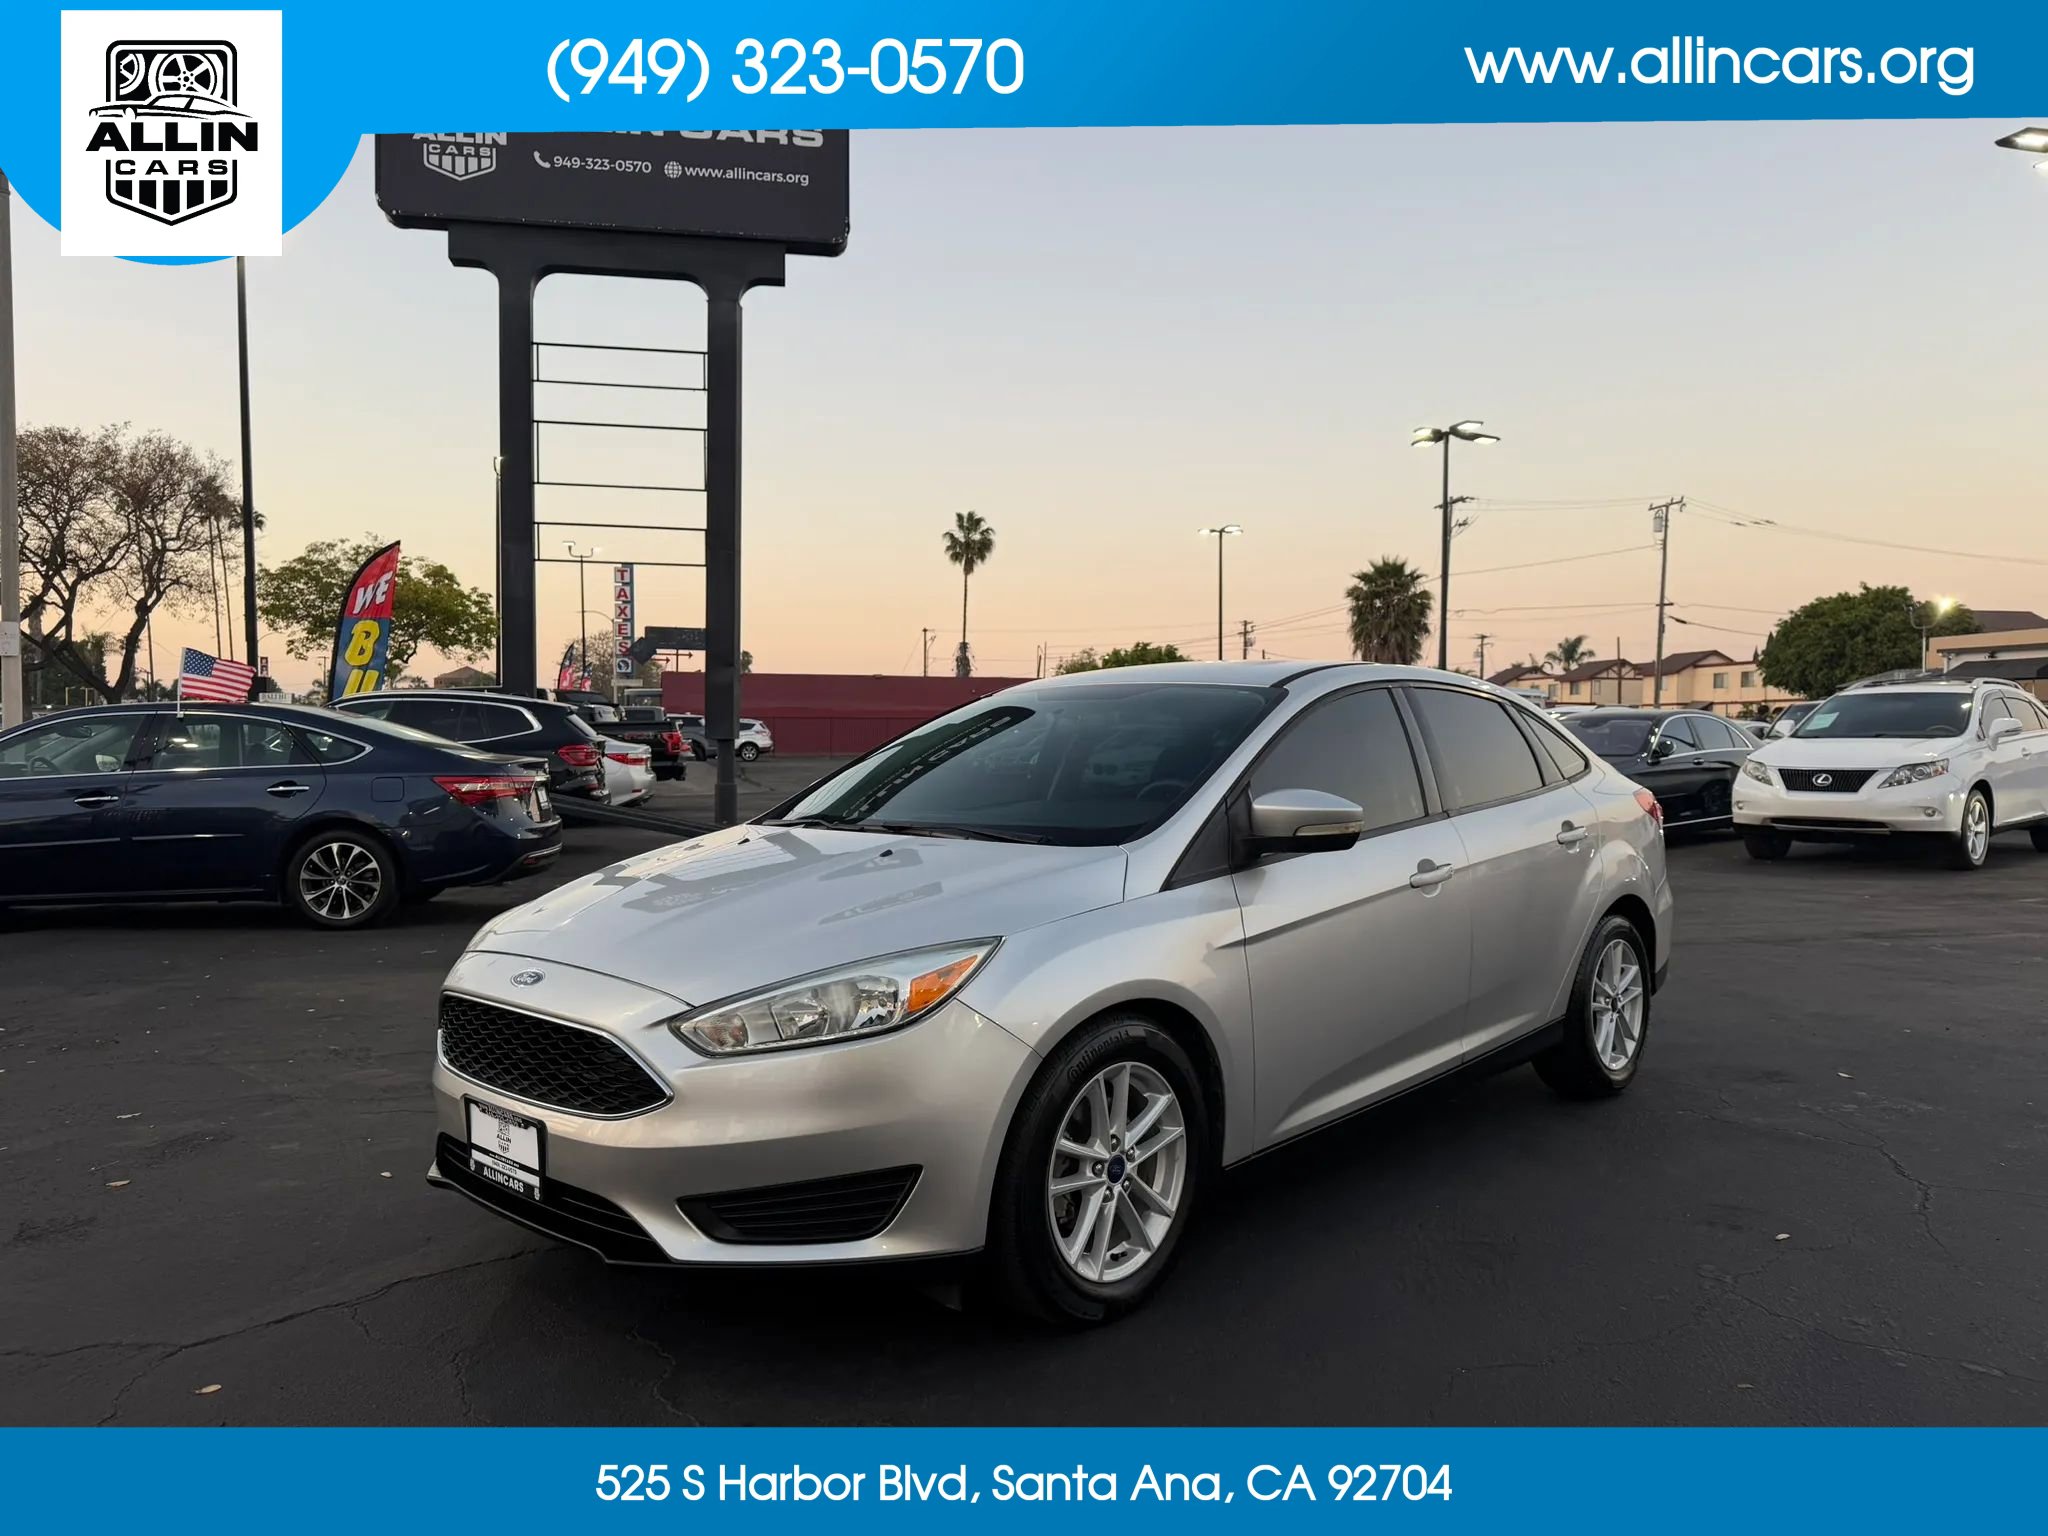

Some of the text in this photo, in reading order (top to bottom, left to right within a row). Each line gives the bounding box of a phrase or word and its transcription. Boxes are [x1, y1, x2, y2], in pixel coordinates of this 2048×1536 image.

[428, 144, 491, 157] CARS
[553, 155, 810, 187] 949-323-0570 www.allincars.org
[352, 570, 394, 615] WE
[616, 567, 631, 656] TAXES
[483, 1166, 524, 1193] ALLINCARS
